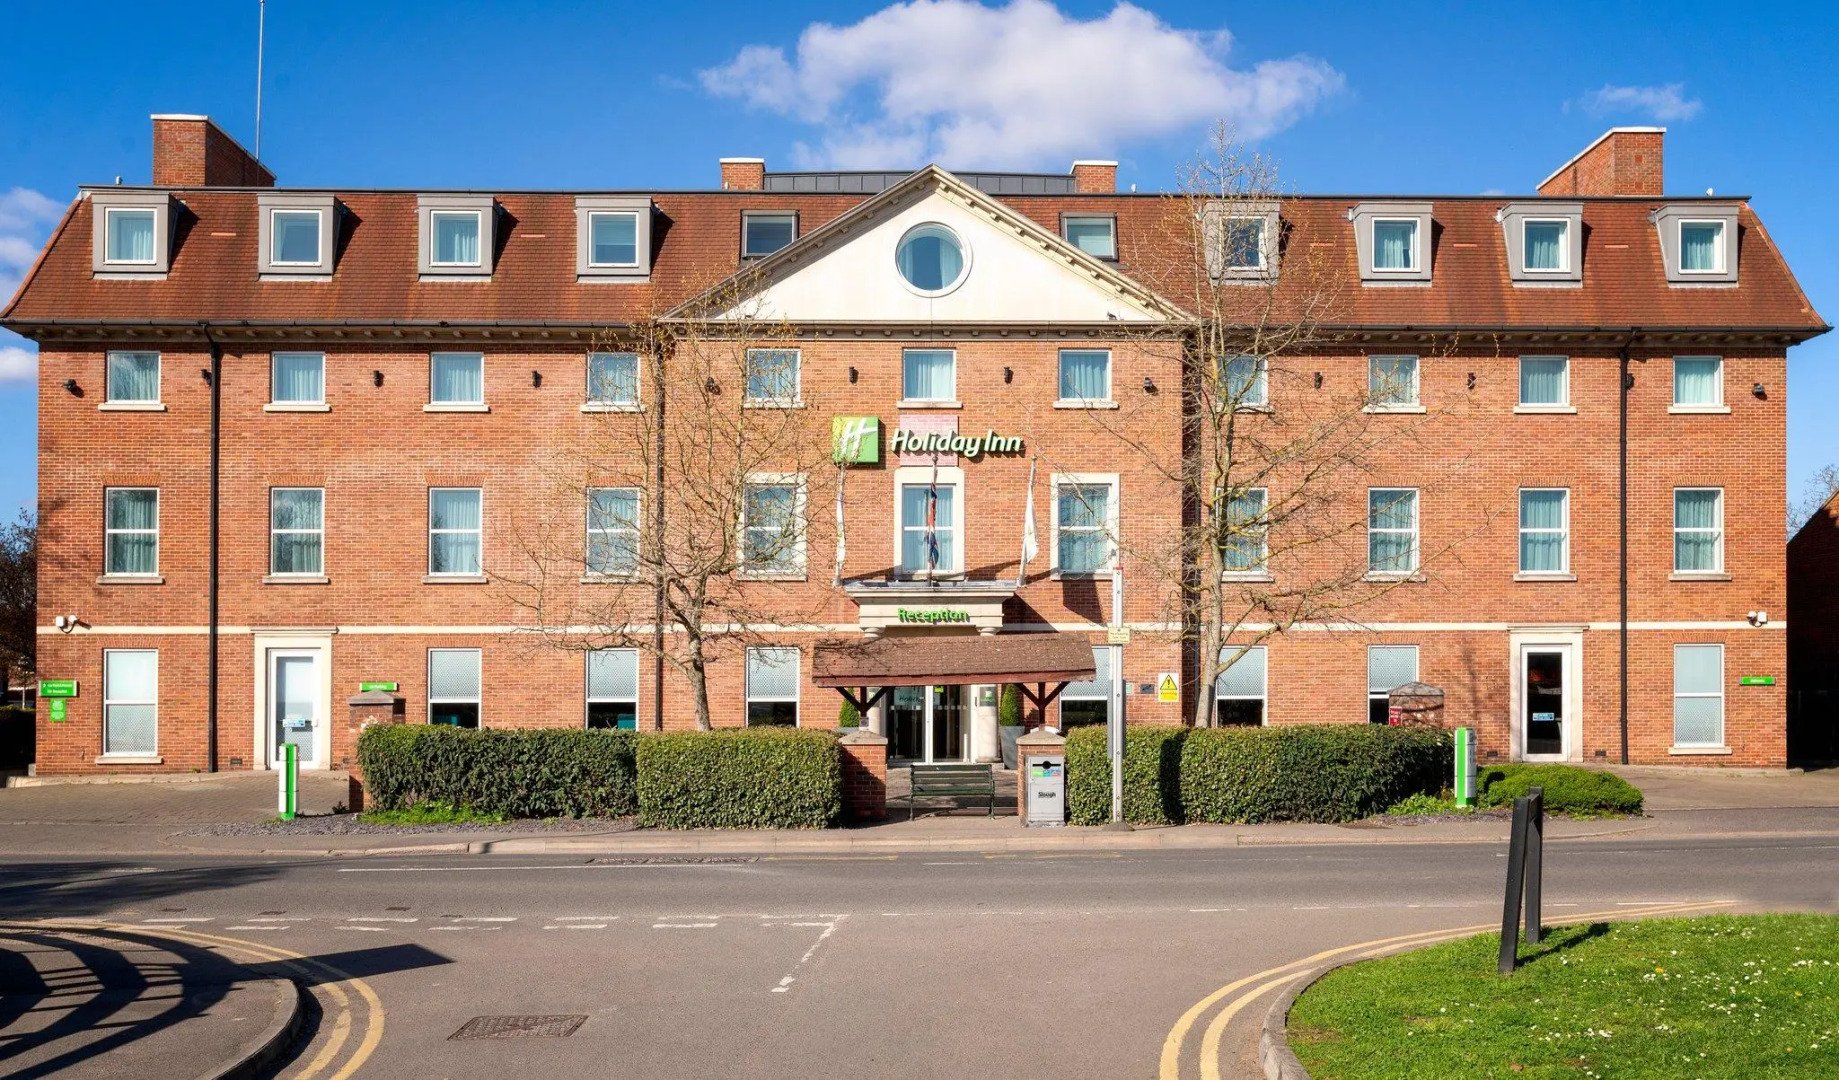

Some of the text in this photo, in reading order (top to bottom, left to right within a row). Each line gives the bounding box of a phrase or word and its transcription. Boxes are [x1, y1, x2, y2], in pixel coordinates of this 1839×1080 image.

[890, 428, 1022, 457] Holiday Inn
[898, 607, 969, 623] Reception
